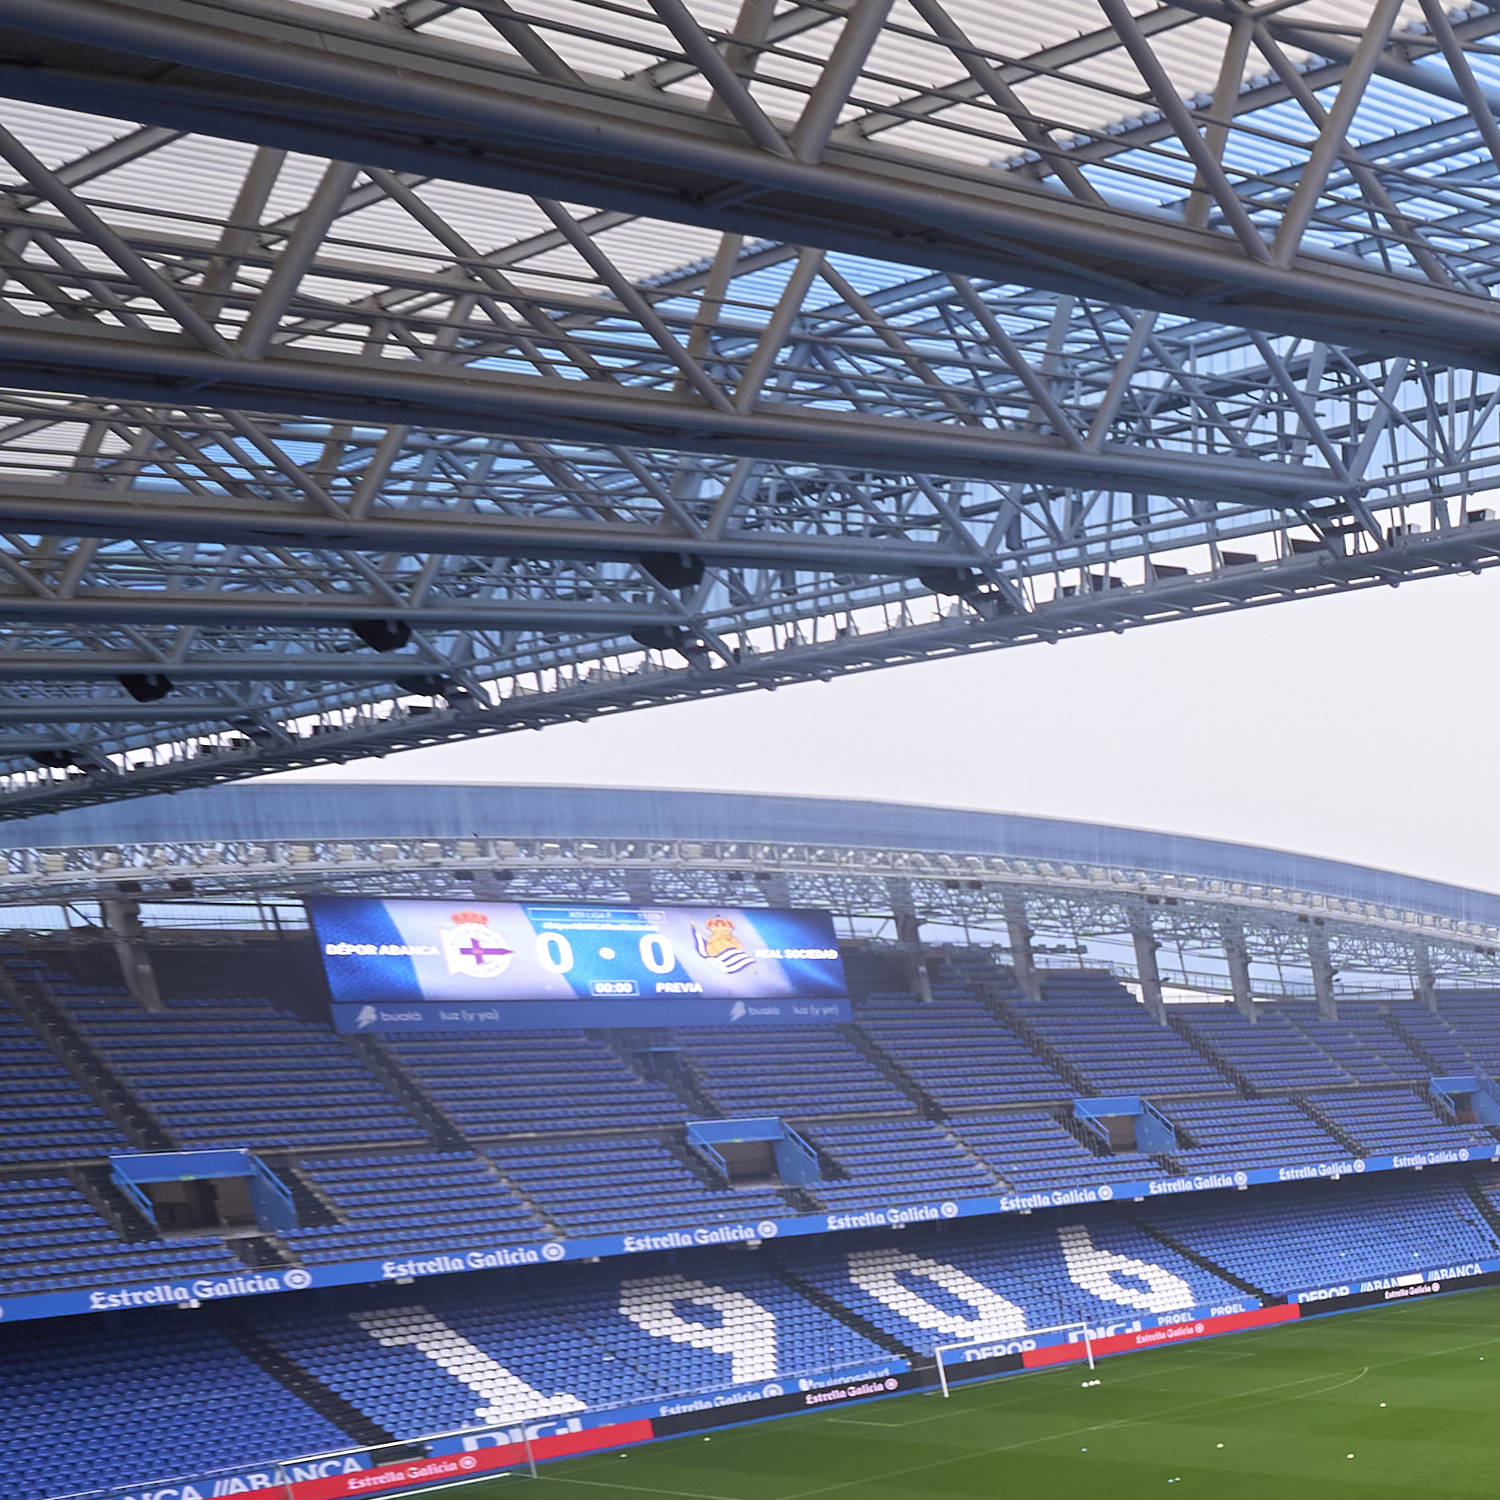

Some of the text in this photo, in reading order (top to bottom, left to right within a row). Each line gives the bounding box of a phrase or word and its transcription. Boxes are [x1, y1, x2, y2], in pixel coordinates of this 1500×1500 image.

[379, 944, 440, 956] ABANCA
[536, 931, 574, 974] 0
[639, 933, 676, 974] 0
[755, 949, 839, 960] REAL SOCIEDAD
[656, 982, 703, 994] PREVIA
[1393, 1149, 1458, 1168] Estrella Galicia
[1279, 1160, 1353, 1181] Estrella Galicia
[1149, 1173, 1233, 1196] Estrella Galicia
[1000, 1187, 1097, 1212] Estrella Galicia
[827, 1202, 940, 1230] Estrella Galicia
[623, 1224, 755, 1252] Estrella Galicia
[382, 1247, 539, 1279] Estrella Galicia
[90, 1275, 280, 1310] Estrella Galicia
[1385, 1285, 1431, 1300] Estrella Galicia
[1157, 1311, 1194, 1326] PROEL
[1210, 1303, 1246, 1317] PROEL
[1136, 1326, 1194, 1344] Estrella Galicia
[659, 1390, 761, 1417] Estrella Galicia
[805, 1382, 885, 1405] Estrella Galicia
[347, 1460, 457, 1490] Estrella Galicia
